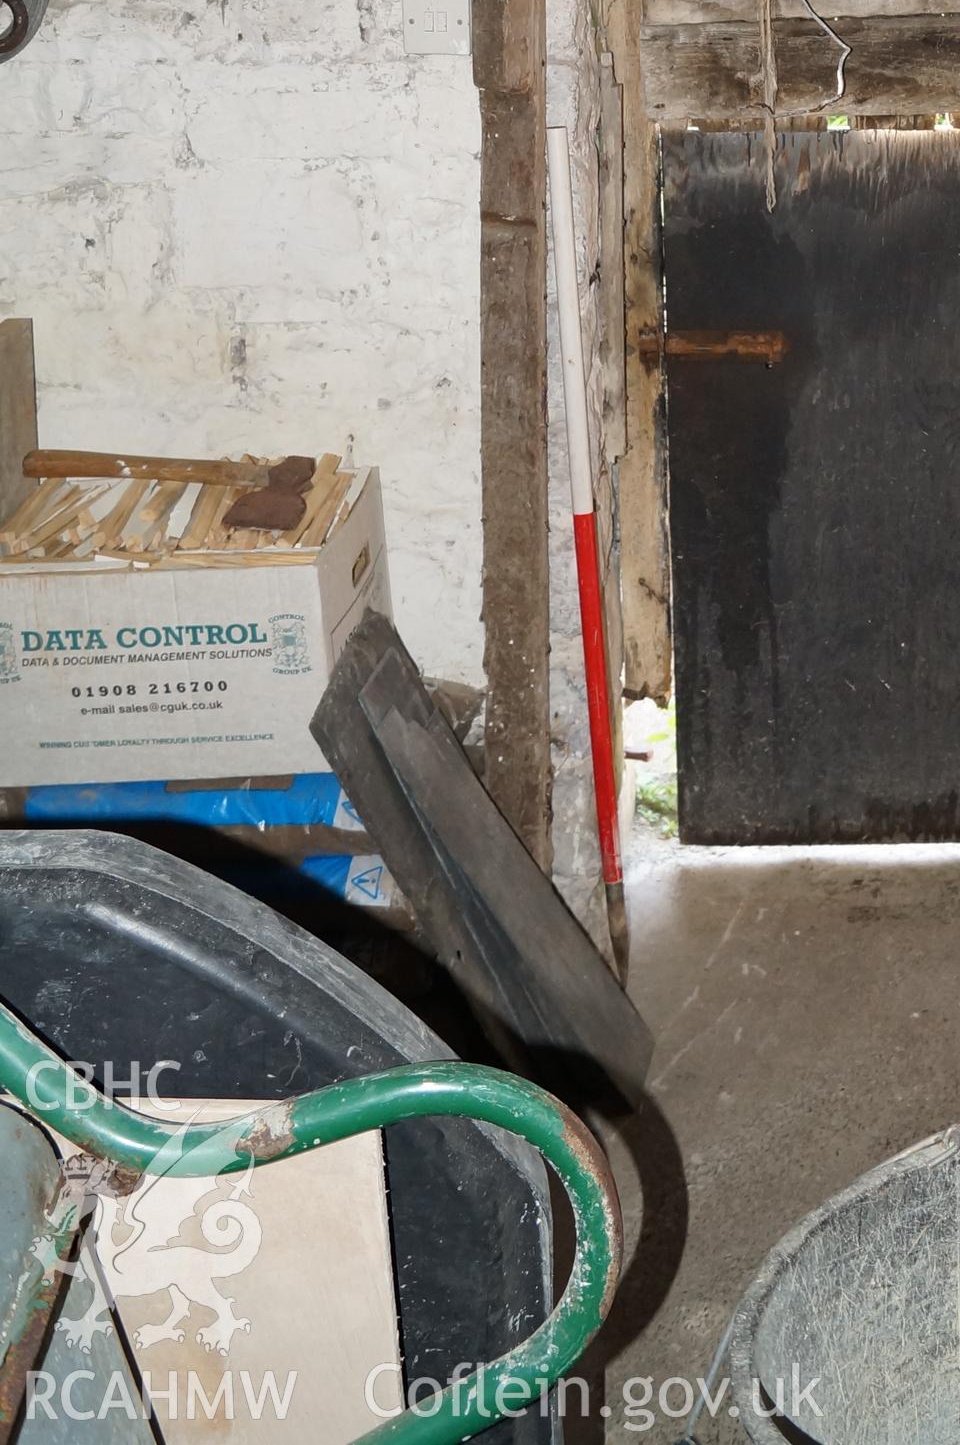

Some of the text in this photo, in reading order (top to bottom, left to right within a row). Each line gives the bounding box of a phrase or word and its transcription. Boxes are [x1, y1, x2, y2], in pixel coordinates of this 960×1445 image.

[20, 623, 268, 652] DATA CONTROL
[22, 648, 273, 668] DATA & DOCUMENT MANAGEMENT SOLUTIONS
[71, 680, 228, 698] 01908 216700
[80, 700, 223, 715] e-mail sales@cguk.co.uk
